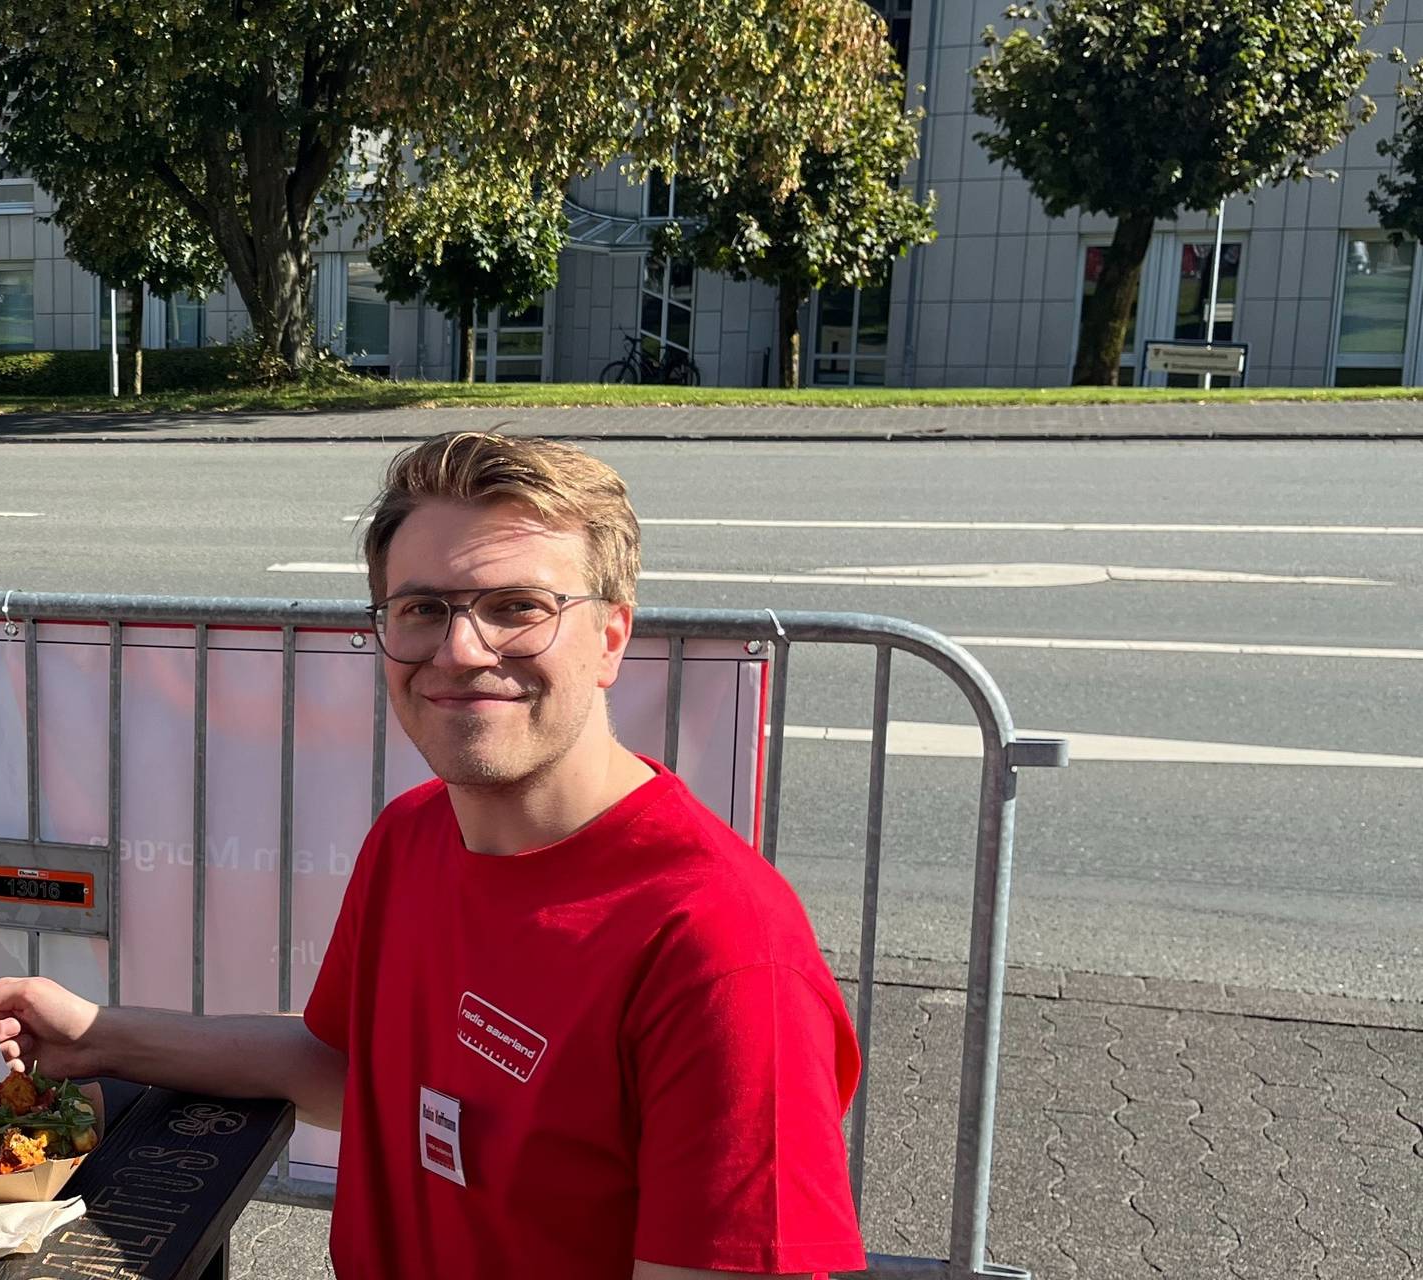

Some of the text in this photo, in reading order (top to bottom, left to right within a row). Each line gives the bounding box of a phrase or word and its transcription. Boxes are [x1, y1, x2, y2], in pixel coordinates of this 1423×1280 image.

[7, 878, 61, 900] 13016
[461, 1008, 537, 1060] radio sauerland
[25, 1145, 220, 1280] ALITOS
